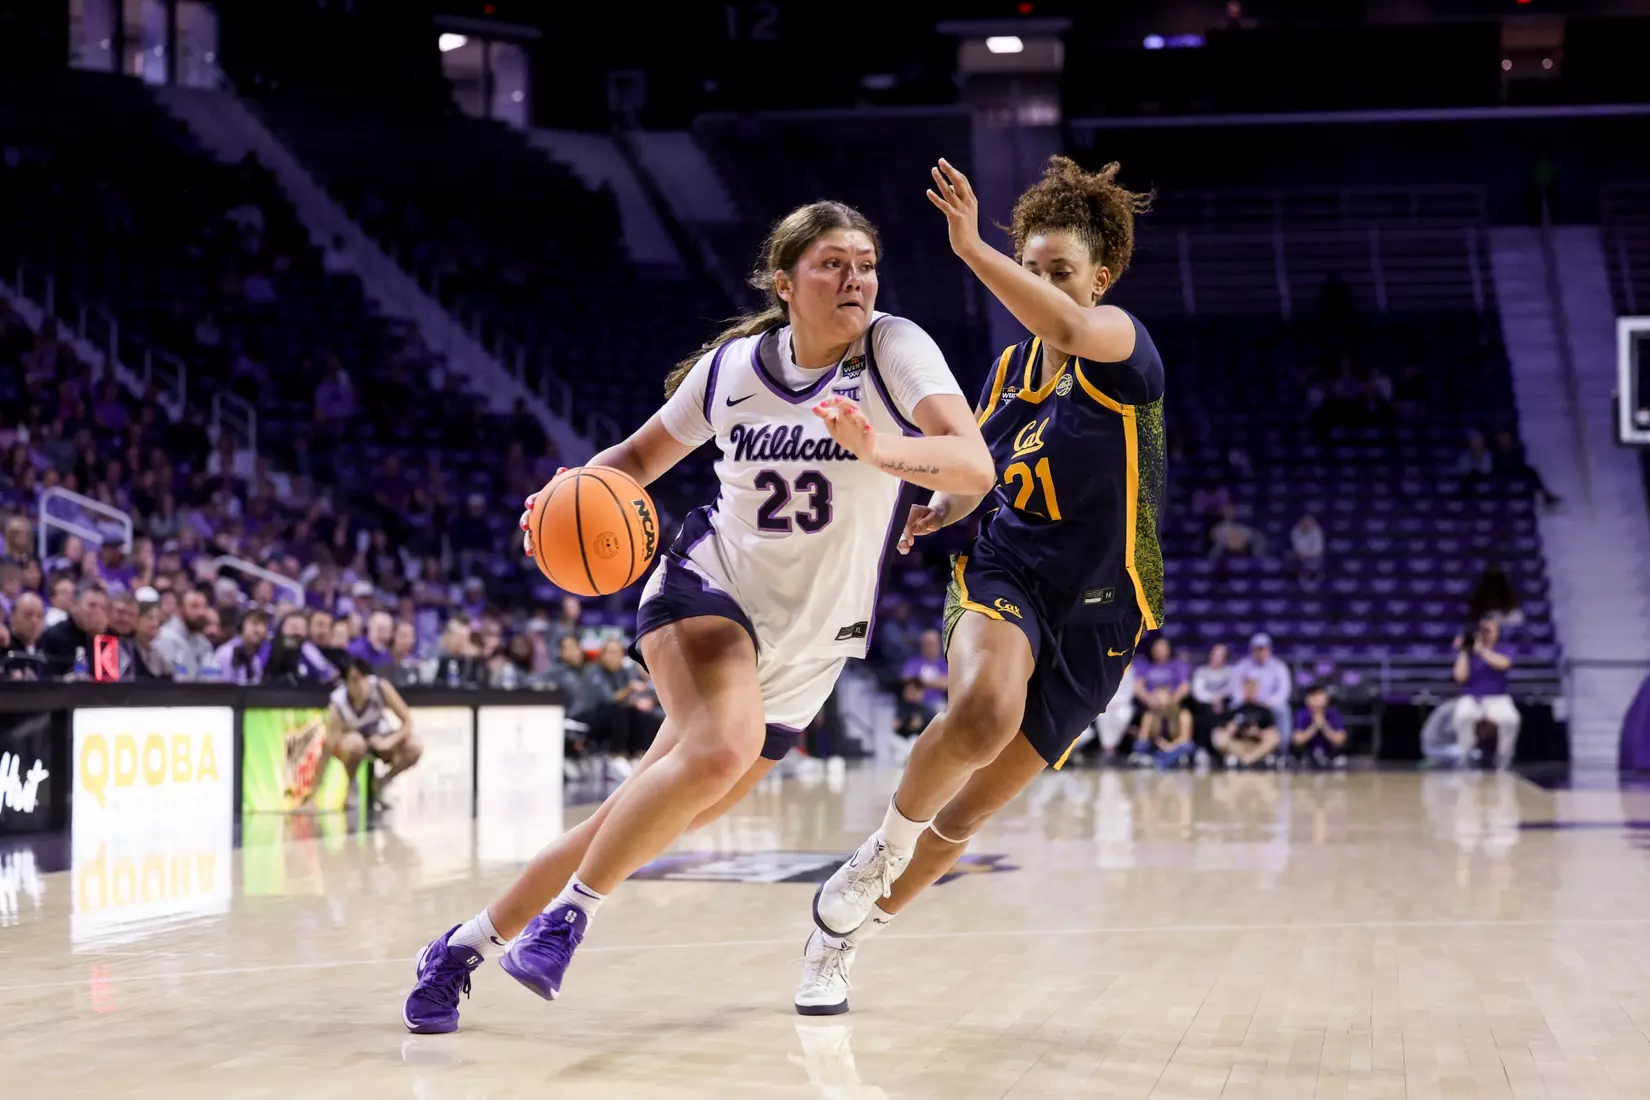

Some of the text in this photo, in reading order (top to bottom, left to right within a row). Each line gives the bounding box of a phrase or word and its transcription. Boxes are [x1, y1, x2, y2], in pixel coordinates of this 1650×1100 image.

[725, 3, 780, 40] 12
[1010, 416, 1050, 460] Cal
[753, 469, 833, 534] 23
[1003, 456, 1062, 521] 21
[632, 498, 655, 562] NCAA
[80, 733, 218, 810] QDOBA
